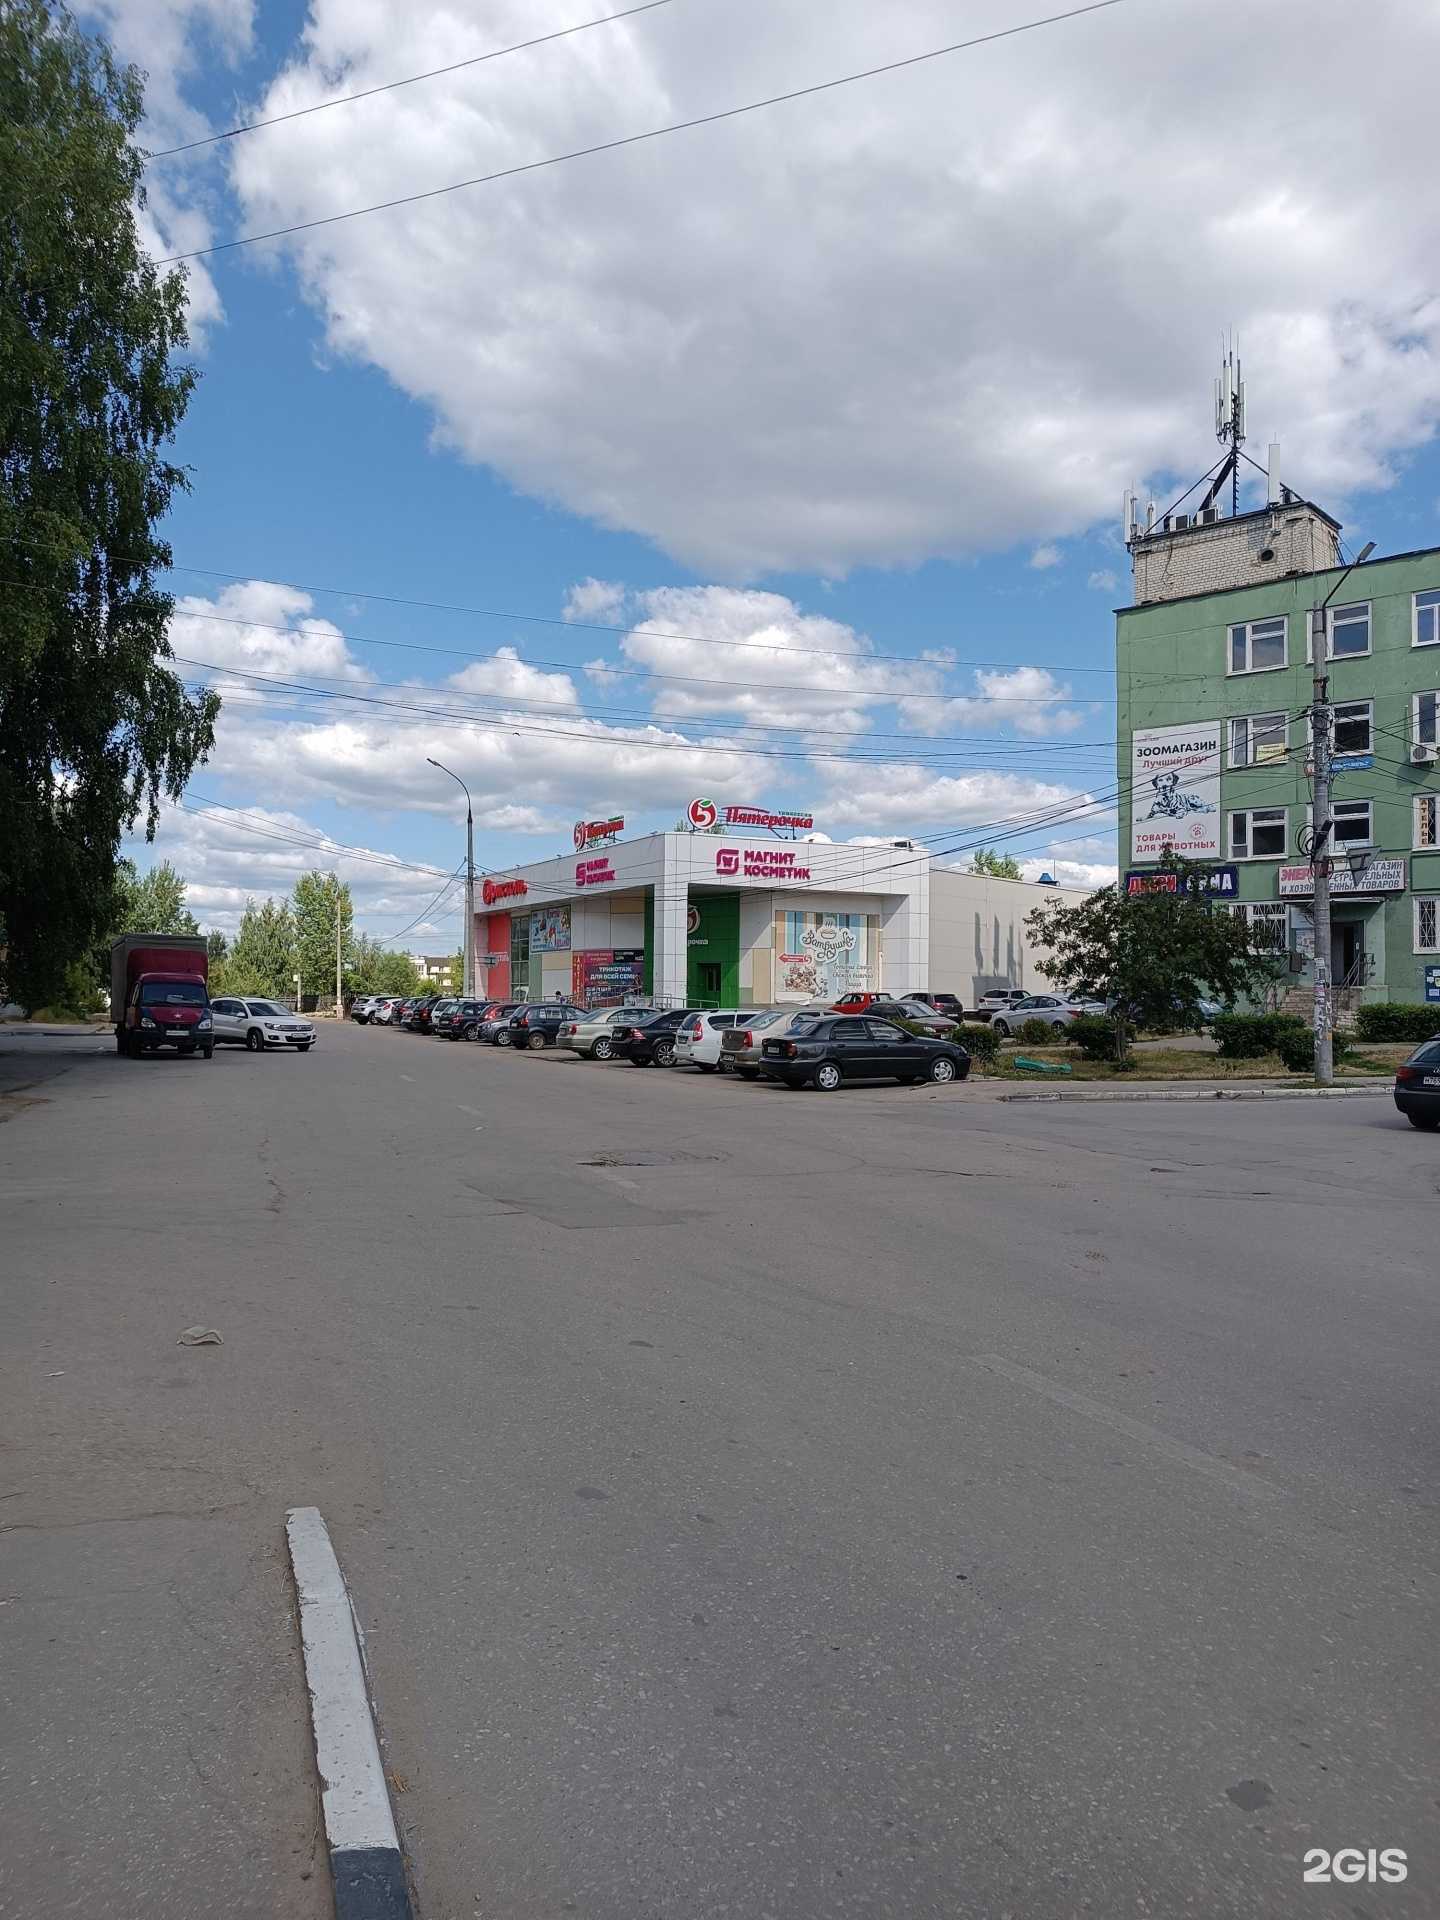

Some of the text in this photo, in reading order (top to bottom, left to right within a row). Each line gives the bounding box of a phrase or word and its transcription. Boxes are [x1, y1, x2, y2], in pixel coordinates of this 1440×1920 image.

[1137, 740, 1216, 758] ЗООМАГАЗИН
[722, 806, 814, 829] Пятерочка
[1420, 799, 1428, 845] АТЕЛЬЕ
[1136, 832, 1176, 842] ТОВАРЫ
[1136, 844, 1156, 853] ДЛЯ
[744, 850, 796, 865] МАГНИТ
[744, 865, 811, 880] КОСМЕТИК
[1368, 861, 1403, 871] АГАЗИН
[1281, 885, 1287, 893] И
[1361, 880, 1400, 890] ТОВАРОВ
